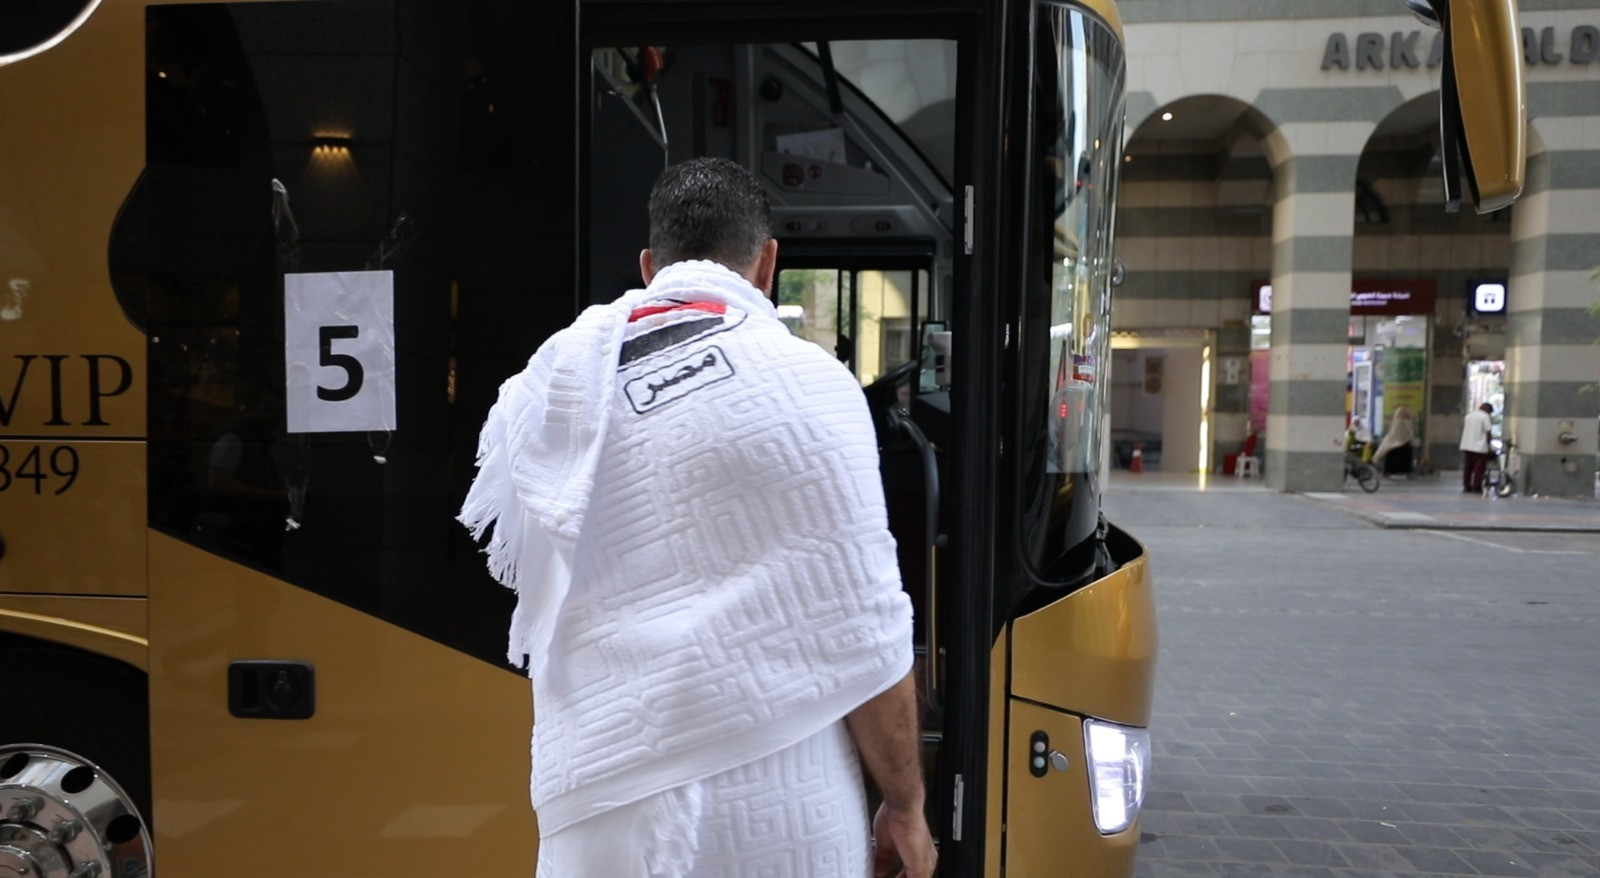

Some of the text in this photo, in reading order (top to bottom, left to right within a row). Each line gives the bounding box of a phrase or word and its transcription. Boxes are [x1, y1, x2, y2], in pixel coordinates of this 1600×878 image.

[0, 354, 133, 427] VIP
[317, 325, 363, 402] 5
[641, 353, 716, 405] مصر
